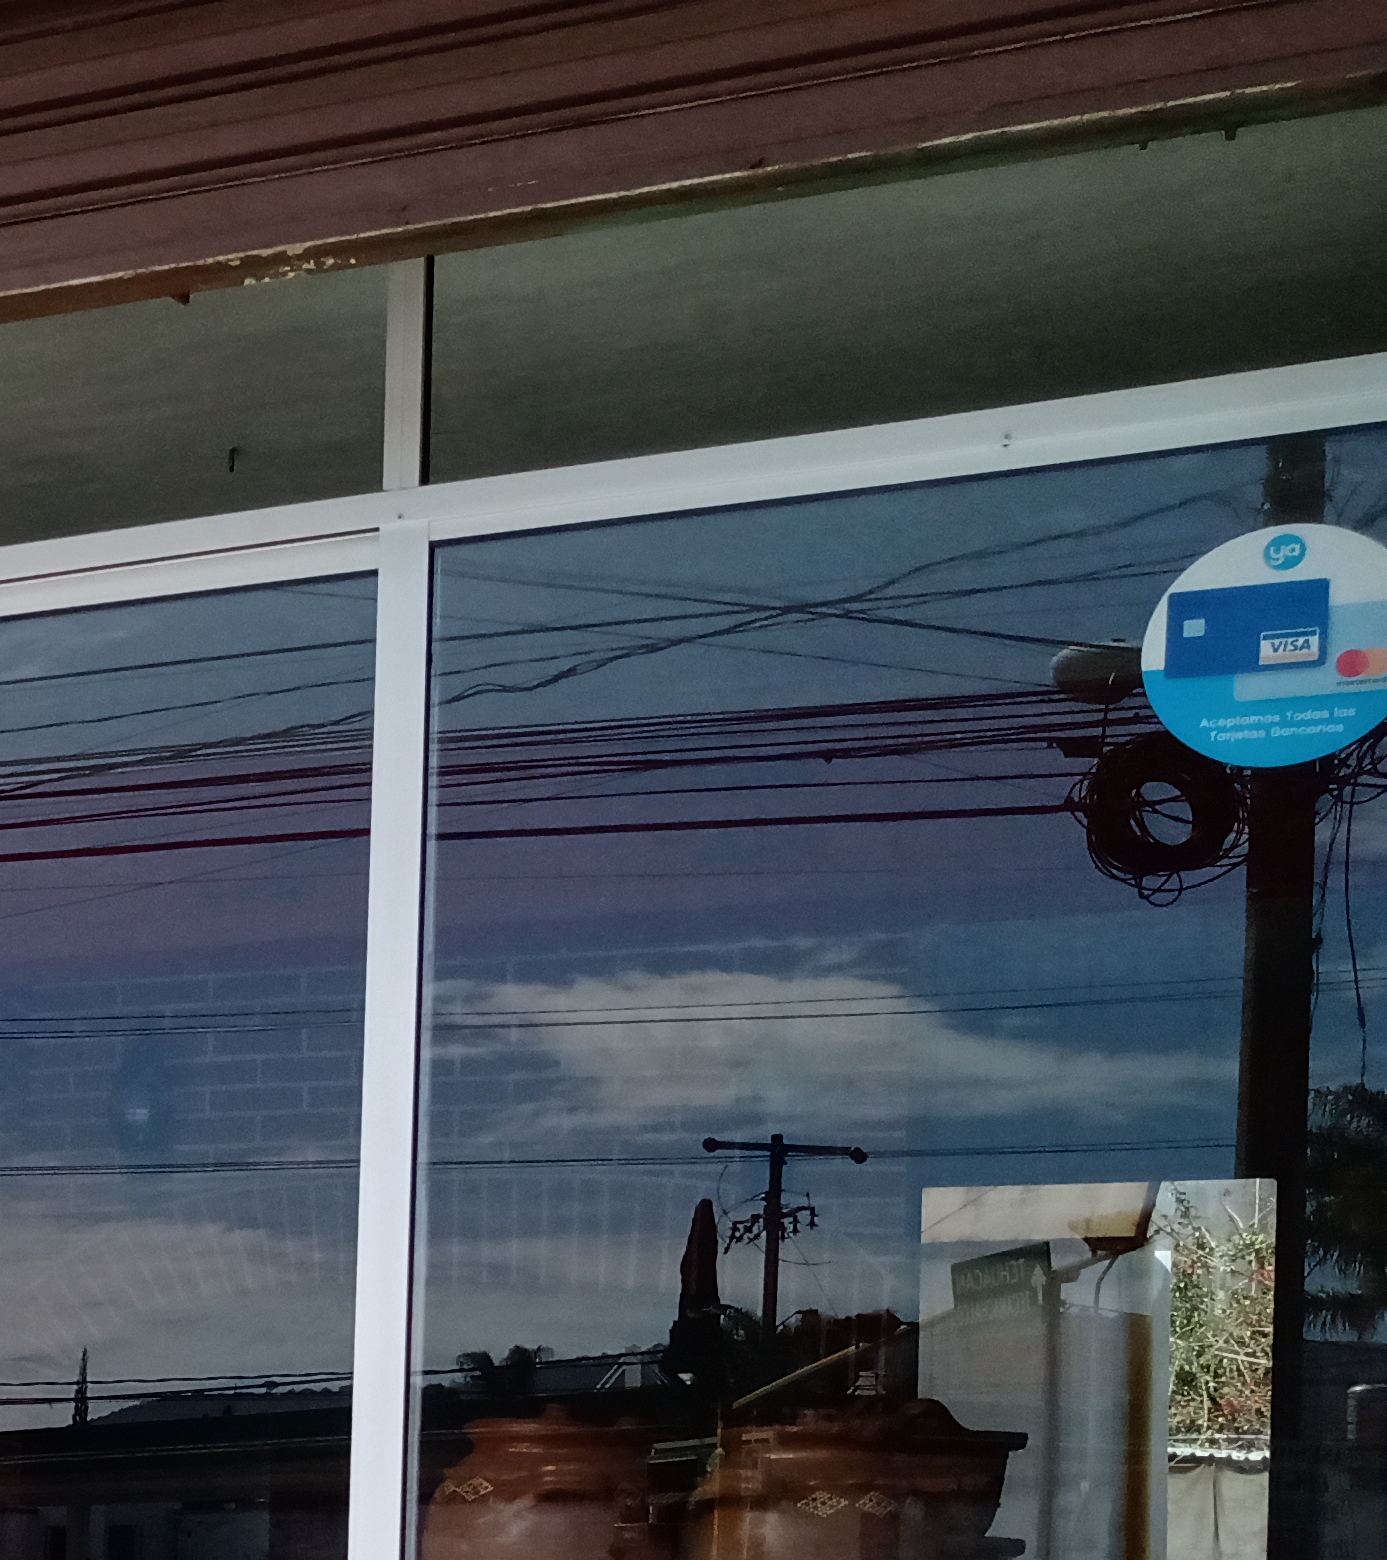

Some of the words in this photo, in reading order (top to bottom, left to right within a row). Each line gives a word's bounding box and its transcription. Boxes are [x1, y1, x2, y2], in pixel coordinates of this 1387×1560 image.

[1270, 638, 1312, 653] VISA
[1199, 713, 1280, 731] Aceptamos
[1286, 708, 1329, 721] Todas
[1210, 729, 1266, 742] Tarjetas
[1270, 723, 1345, 737] Bancarias
